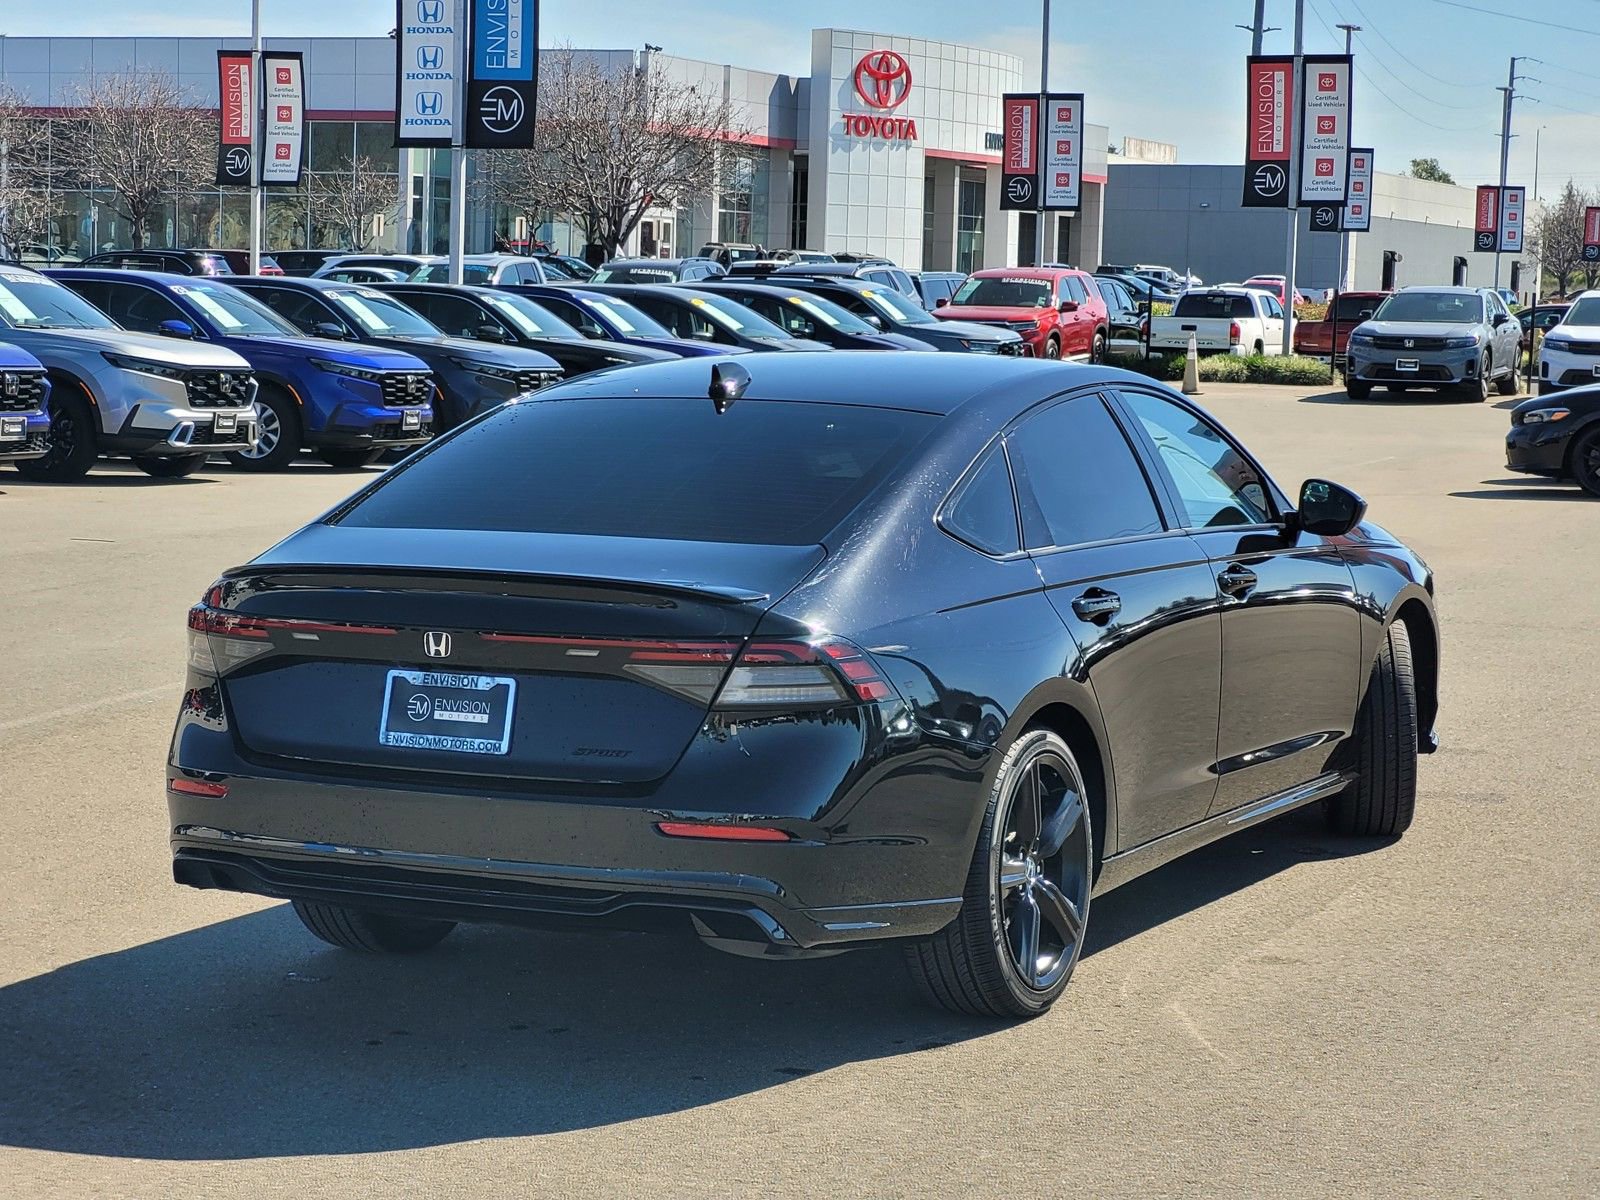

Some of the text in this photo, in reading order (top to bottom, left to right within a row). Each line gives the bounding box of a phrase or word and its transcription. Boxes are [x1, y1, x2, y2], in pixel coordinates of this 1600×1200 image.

[228, 64, 240, 137] ENVISION
[1258, 71, 1273, 152] ENVISION
[842, 114, 918, 140] TOYOTA
[1011, 106, 1022, 168] ENVISION
[423, 674, 478, 688] ENVISION
[434, 699, 490, 714] ENVISION
[438, 713, 484, 722] MOTORS
[386, 734, 501, 752] ENVISIONMOTORS.COM
[572, 748, 632, 758] SPORT
